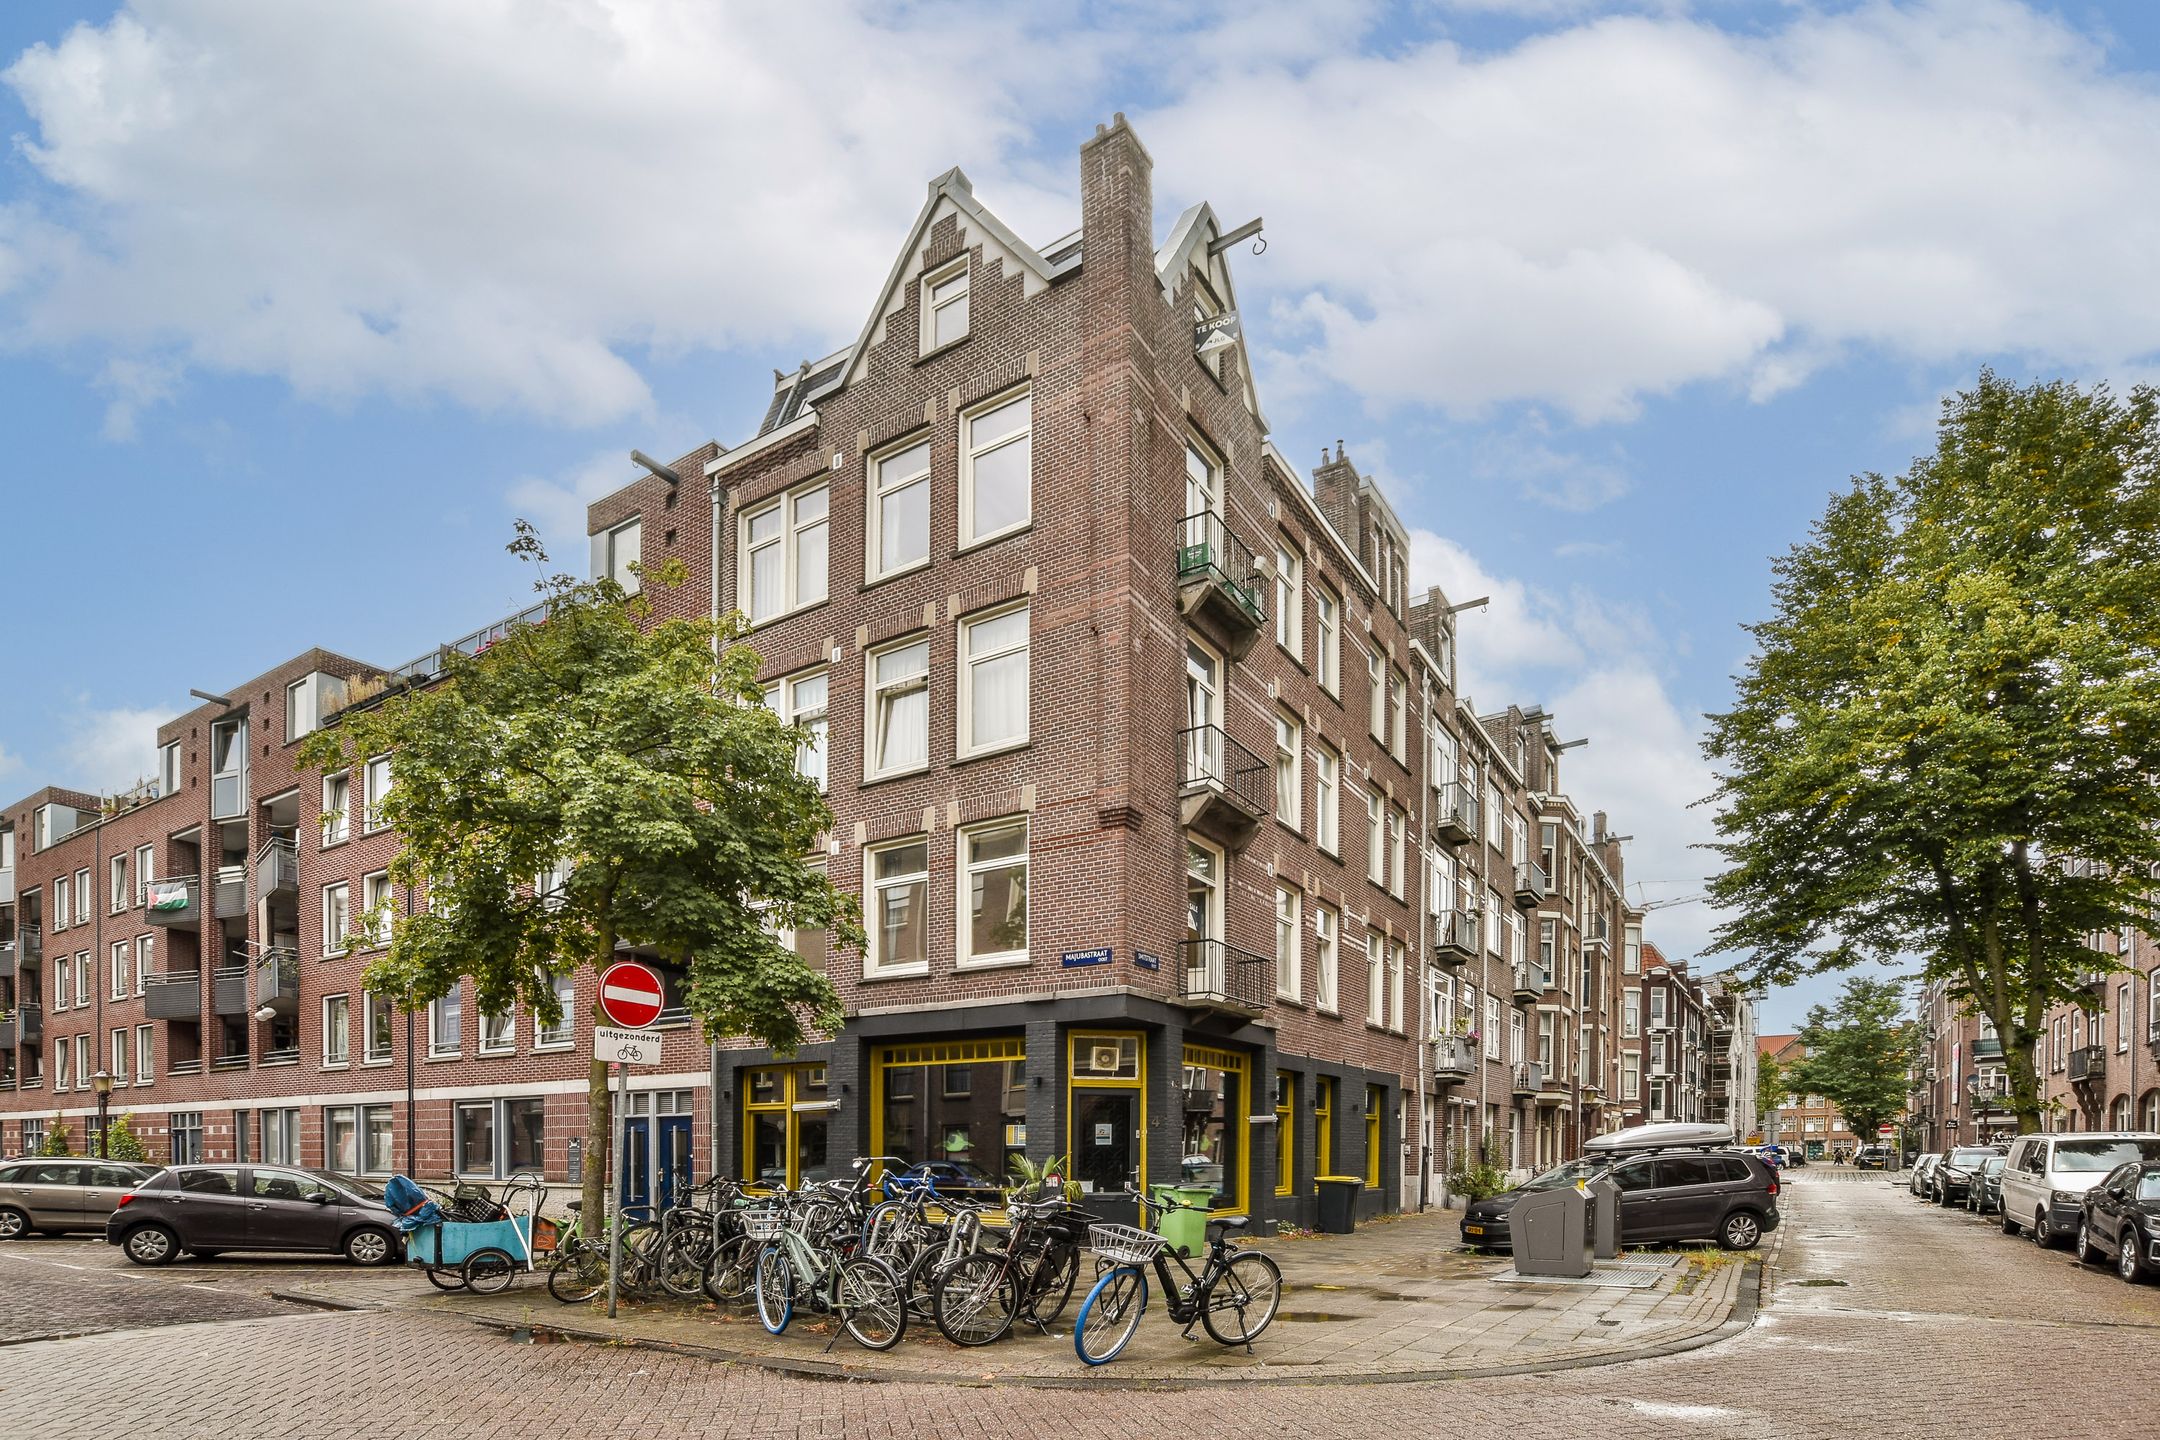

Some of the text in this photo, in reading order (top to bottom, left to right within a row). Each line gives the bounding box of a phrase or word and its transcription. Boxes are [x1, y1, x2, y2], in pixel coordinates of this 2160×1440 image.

[1196, 316, 1236, 334] TE KOOP
[1065, 950, 1108, 962] MAJUBASTRAAT
[599, 1030, 660, 1043] uitgezonderd
